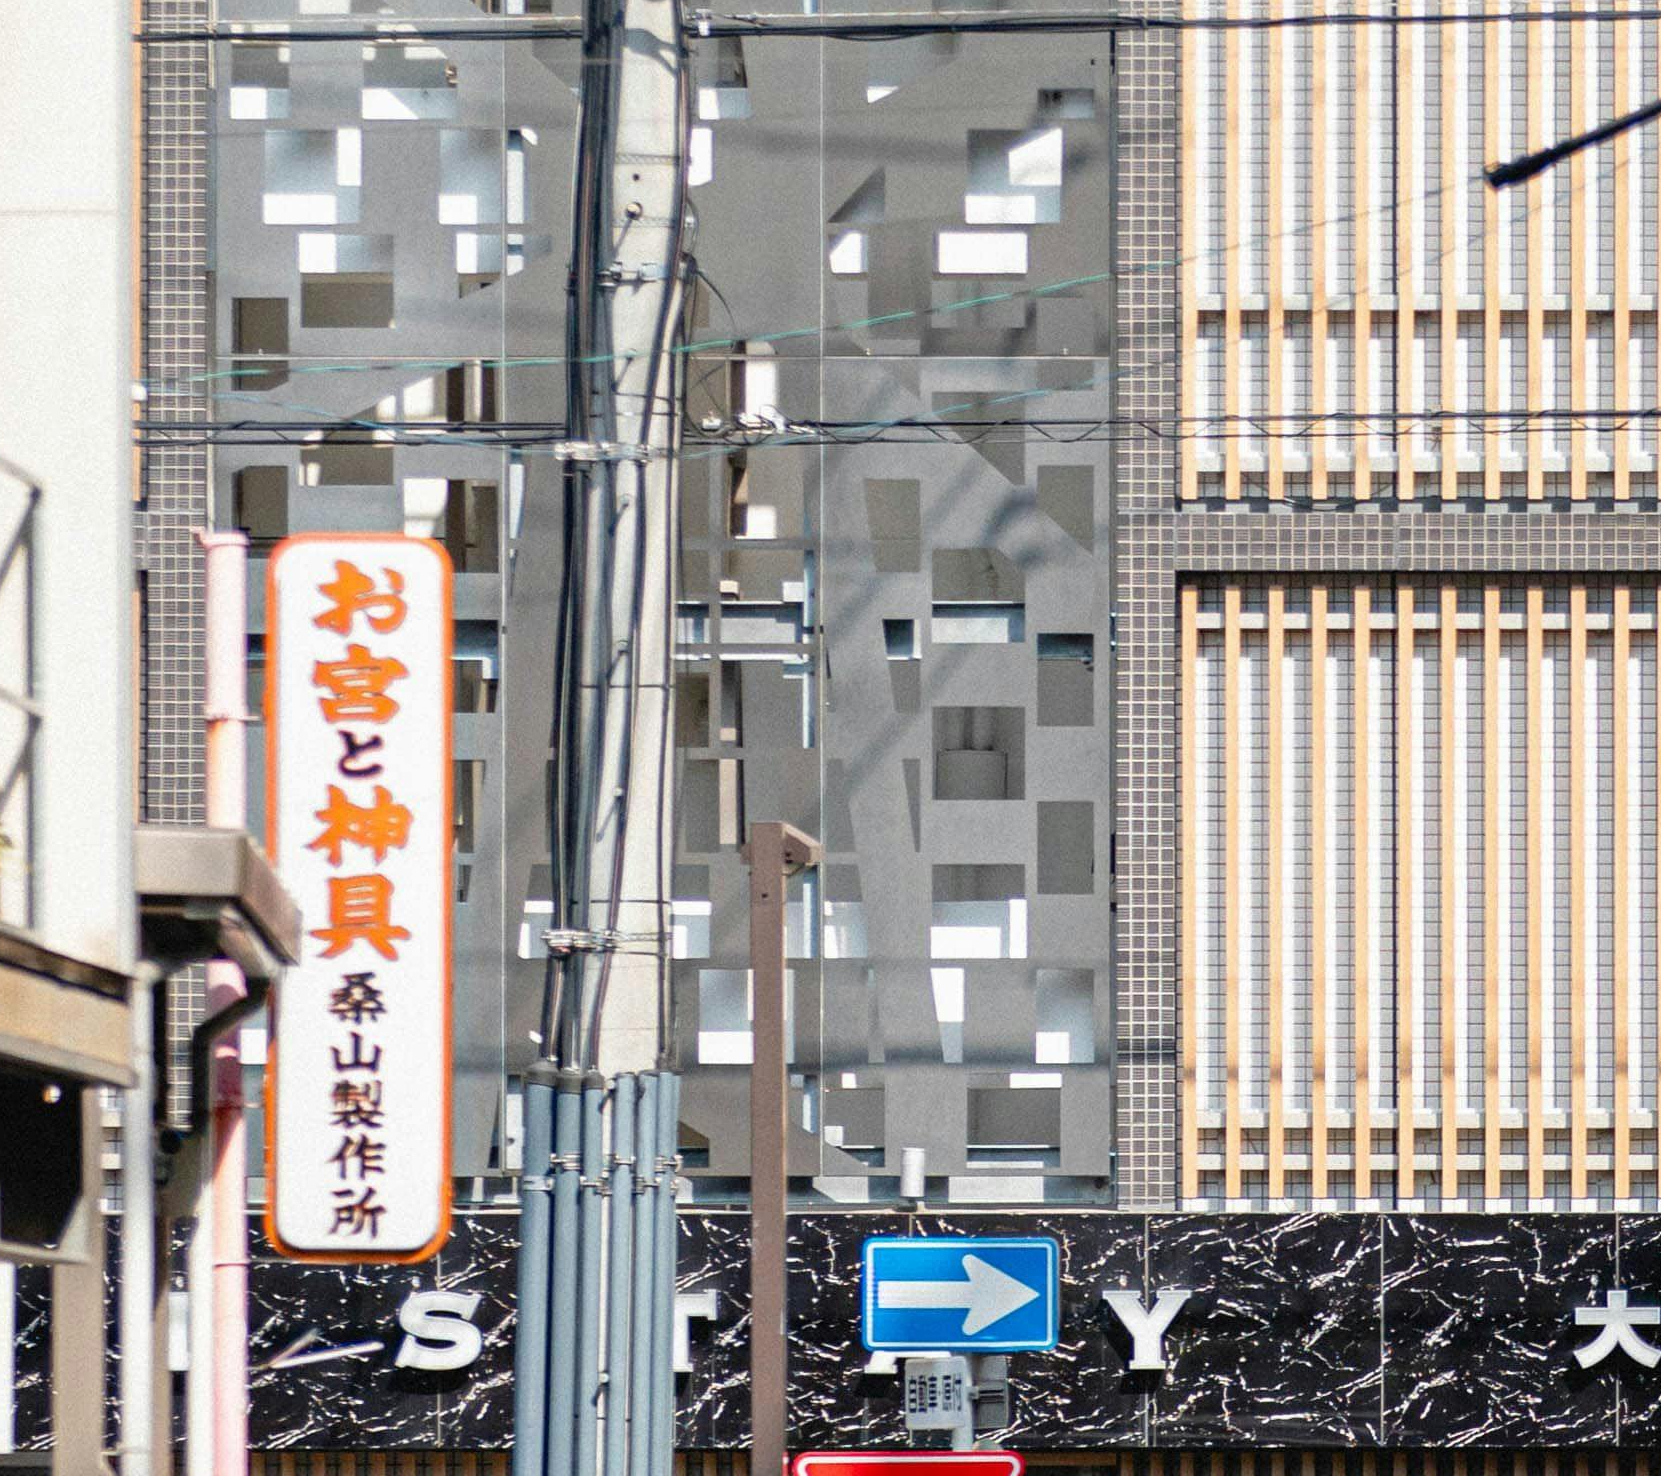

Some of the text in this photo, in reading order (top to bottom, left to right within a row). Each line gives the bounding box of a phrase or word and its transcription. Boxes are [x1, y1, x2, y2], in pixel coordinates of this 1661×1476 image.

[304, 560, 415, 961] お宮と神具
[327, 971, 387, 1239] 桑山製作所
